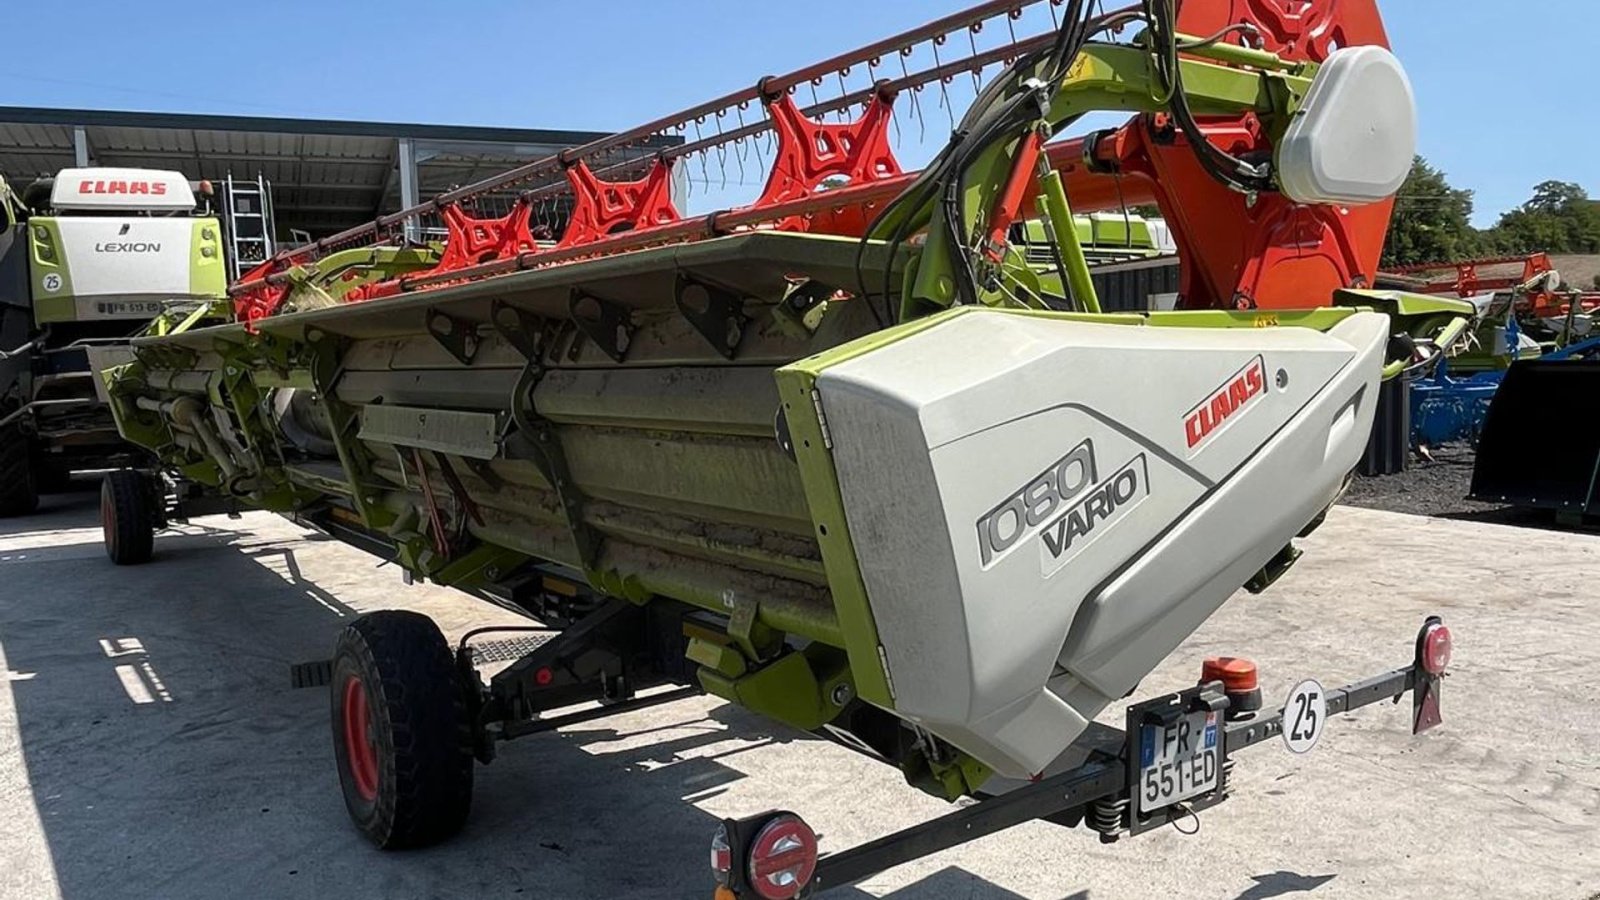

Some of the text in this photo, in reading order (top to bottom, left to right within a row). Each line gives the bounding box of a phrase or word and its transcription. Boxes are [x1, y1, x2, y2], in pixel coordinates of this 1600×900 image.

[79, 180, 166, 195] CLAAS
[95, 243, 161, 253] LEXION
[47, 275, 59, 289] 25
[1185, 362, 1264, 449] CLAAS
[977, 447, 1092, 567] 1080
[1042, 467, 1138, 559] VARIO
[1290, 692, 1318, 741] 25
